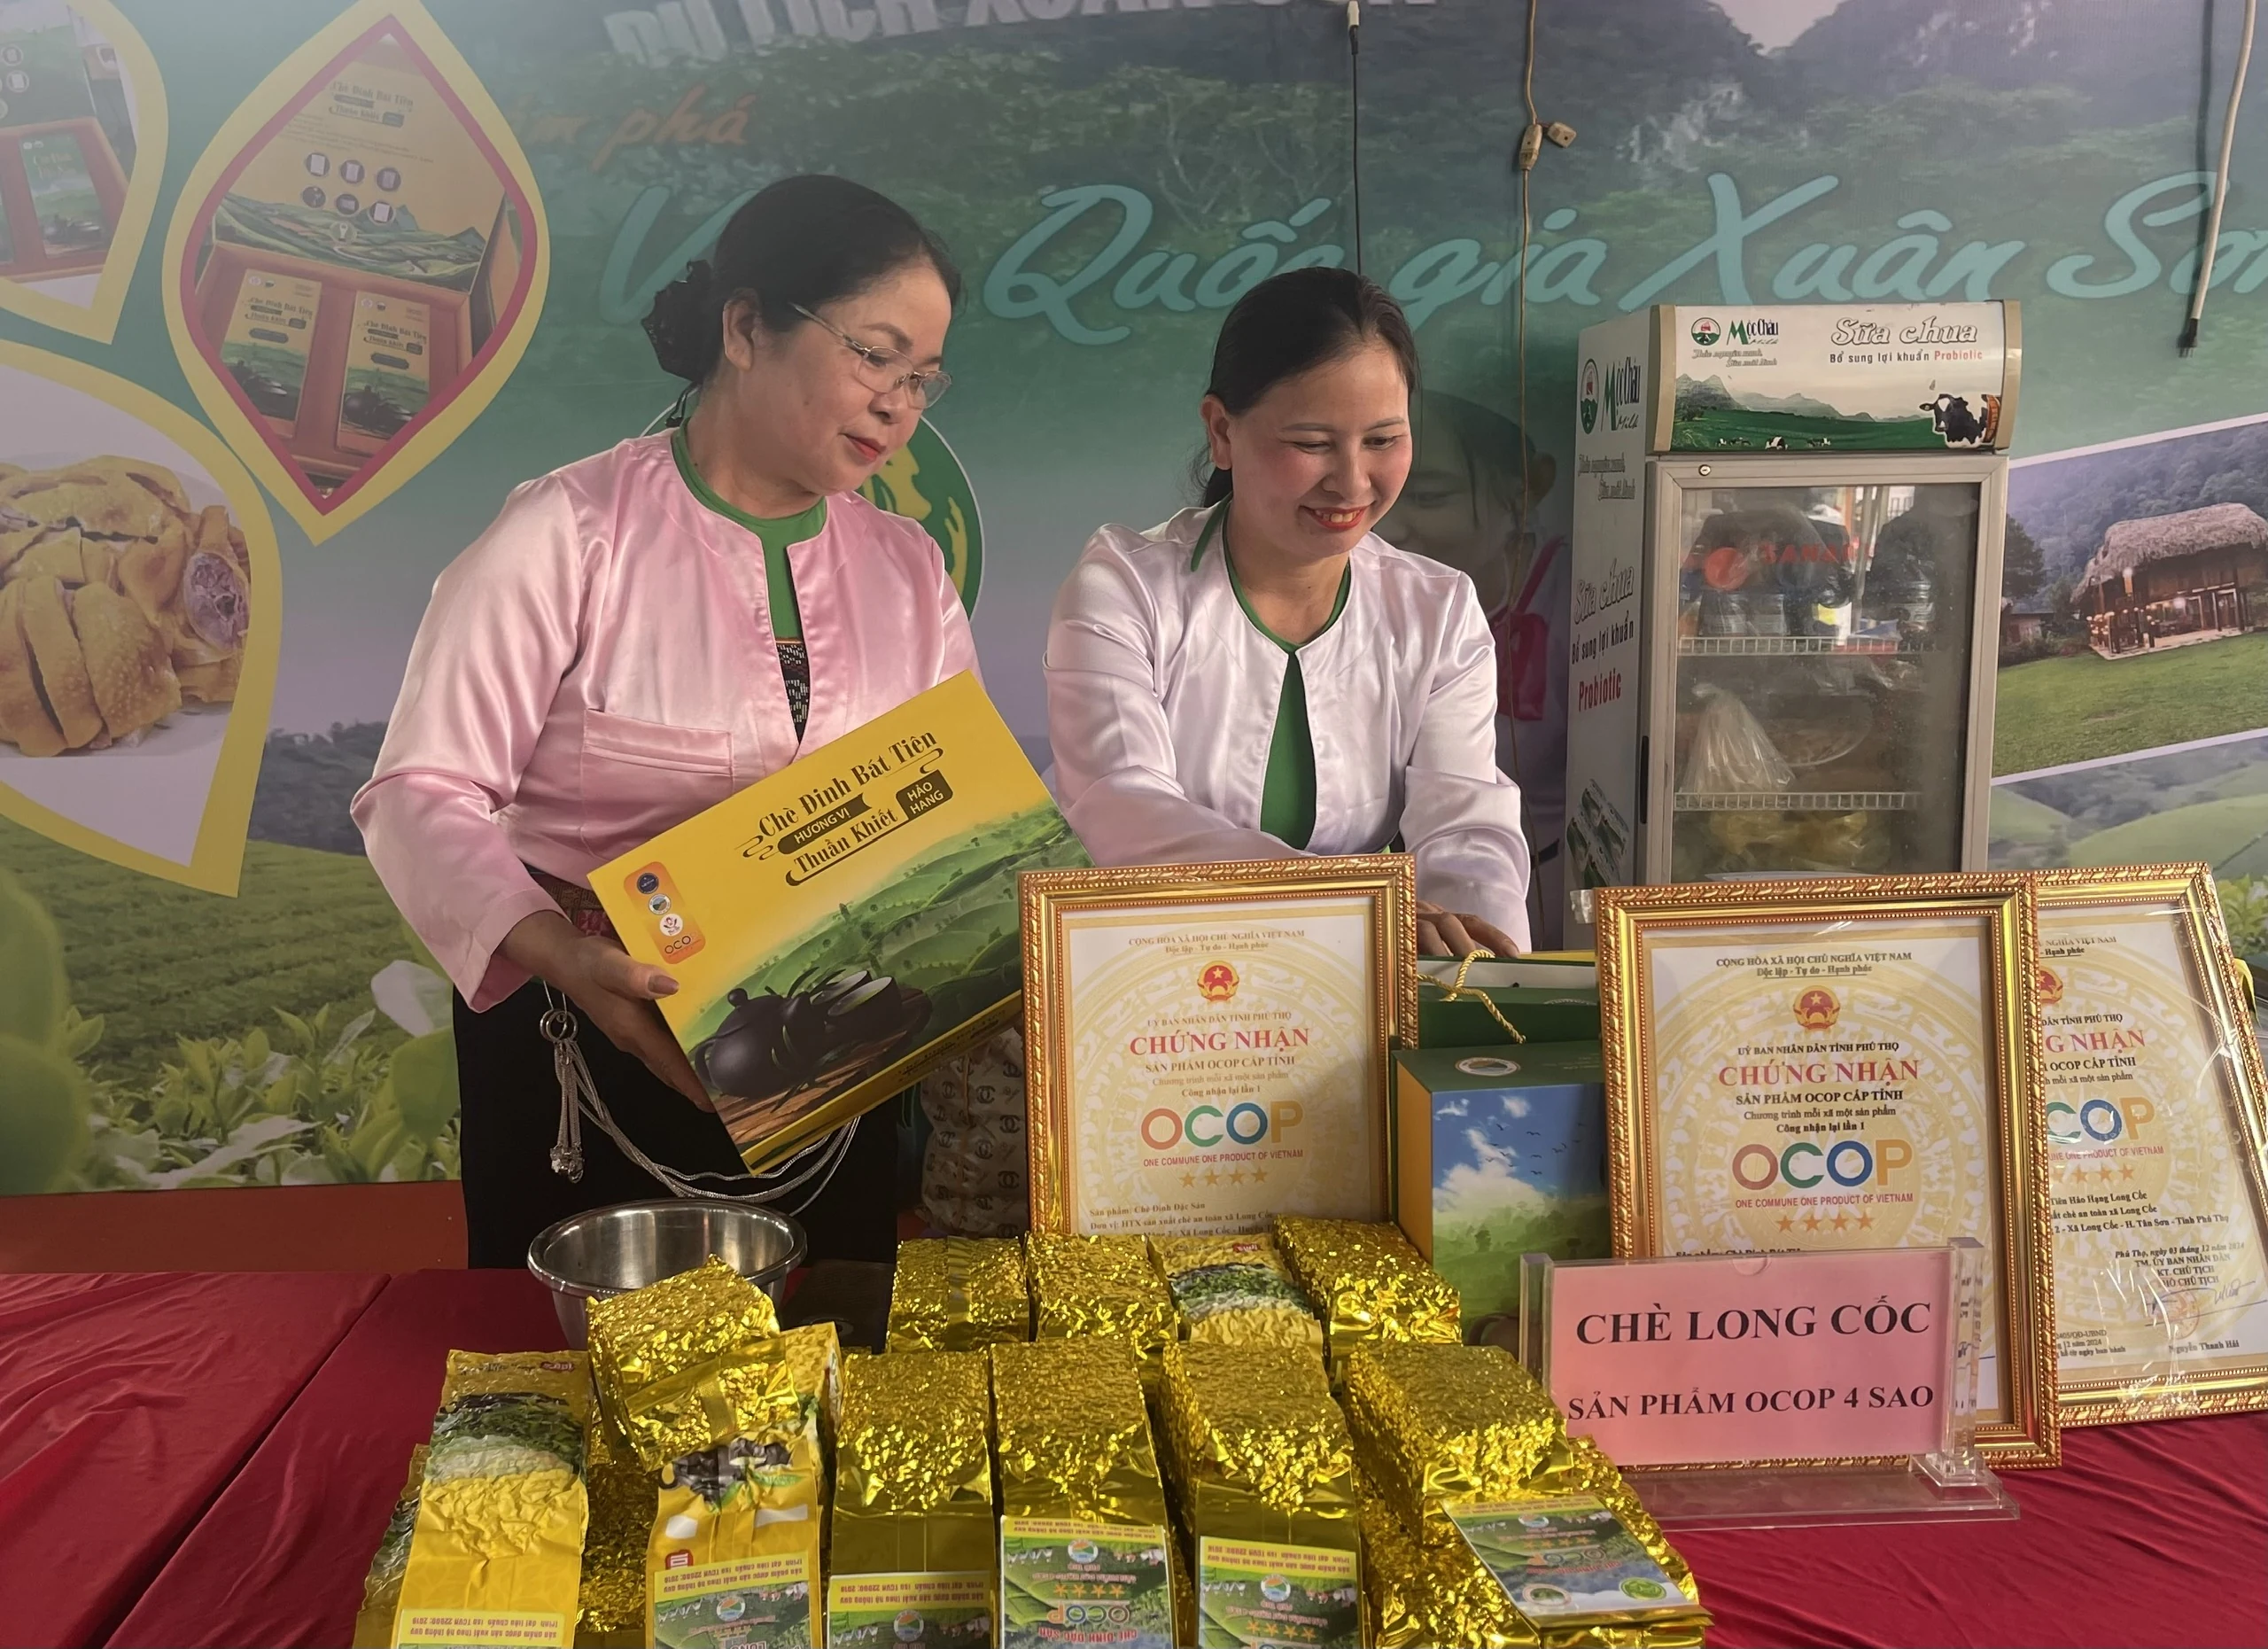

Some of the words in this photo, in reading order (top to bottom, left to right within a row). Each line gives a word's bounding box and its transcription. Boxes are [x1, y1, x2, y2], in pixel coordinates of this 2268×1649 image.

[1387, 208, 1608, 333] gia
[1617, 173, 2026, 306] Xuân
[1830, 317, 1891, 346] Sữa
[1899, 315, 1978, 344] chua
[1830, 351, 1844, 363] Bổ
[1848, 354, 1873, 364] sung
[1878, 352, 1892, 364] lợi
[1897, 348, 1930, 362] khuẩn
[1934, 349, 1983, 361] Probiotic
[1579, 667, 1621, 712] Probiotic
[758, 806, 799, 837] Chè
[850, 755, 891, 786] Bát
[888, 732, 937, 764] Tiên
[906, 782, 933, 802] HẢO
[794, 814, 838, 844] HƯƠNG
[835, 807, 851, 821] VỊ
[794, 837, 851, 875] Thuần
[850, 807, 899, 844] Khiết
[1716, 958, 1744, 968] CỘNG
[1747, 957, 1769, 966] HÒA
[1771, 955, 1785, 965] XÃ
[1786, 955, 1805, 965] HỘI
[1807, 954, 1828, 964] CHỦ
[1830, 953, 1862, 963] NGHĨA
[1864, 953, 1887, 961] VIỆT
[1130, 1030, 1227, 1055] CHỨNG
[1233, 1026, 1309, 1053] NHẬN
[1775, 1044, 1804, 1054] NHÂN
[1806, 1043, 1828, 1054] DÂN
[1829, 1043, 1853, 1053] TỈNH
[1855, 1042, 1876, 1052] PHÚ
[1877, 1042, 1899, 1053] THỌ
[2070, 1028, 2146, 1054] NHẬN
[1719, 1059, 1827, 1086] CHỨNG
[1836, 1057, 1919, 1086] NHẬN
[2050, 1060, 2081, 1071] OCOP
[2083, 1057, 2106, 1069] CẤP
[2107, 1055, 2137, 1068] TỈNH
[1736, 1093, 1761, 1105] SẢN
[1764, 1093, 1802, 1104] PHẨM
[1805, 1092, 1841, 1103] OCOP
[1843, 1090, 1869, 1101] CẤP
[1871, 1090, 1903, 1101] TỈNH
[1141, 1100, 1303, 1150] OCOP
[1776, 1123, 1801, 1133] Công
[1804, 1122, 1826, 1132] nhận
[1829, 1121, 1840, 1132] lại
[1843, 1120, 1857, 1131] lần
[2046, 1096, 2155, 1144] COP
[1143, 1158, 1159, 1167] ONE
[1161, 1155, 1200, 1166] COMMUNE
[1202, 1155, 1218, 1163] ONE
[1220, 1152, 1255, 1162] PRODUCT
[1270, 1149, 1303, 1159] VIETNAM
[1732, 1139, 1913, 1191] OCOP
[1736, 1199, 1752, 1209] ONE
[1755, 1197, 1798, 1208] COMMUNE
[1801, 1197, 1818, 1206] ONE
[1821, 1194, 1860, 1205] PRODUCT
[1863, 1194, 1874, 1203] OF
[1876, 1193, 1914, 1202] VIETNAM
[1576, 1303, 1673, 1345] CHÈ
[1686, 1305, 1816, 1342] LONG
[1830, 1295, 1932, 1335] CỐC
[1568, 1391, 1631, 1420] SẢN
[1640, 1386, 1735, 1416] PHẨM
[1744, 1388, 1836, 1412] OCOP
[1844, 1387, 1859, 1409] 4
[1868, 1385, 1934, 1409] SAO
[1046, 1602, 1130, 1625] OCOP
